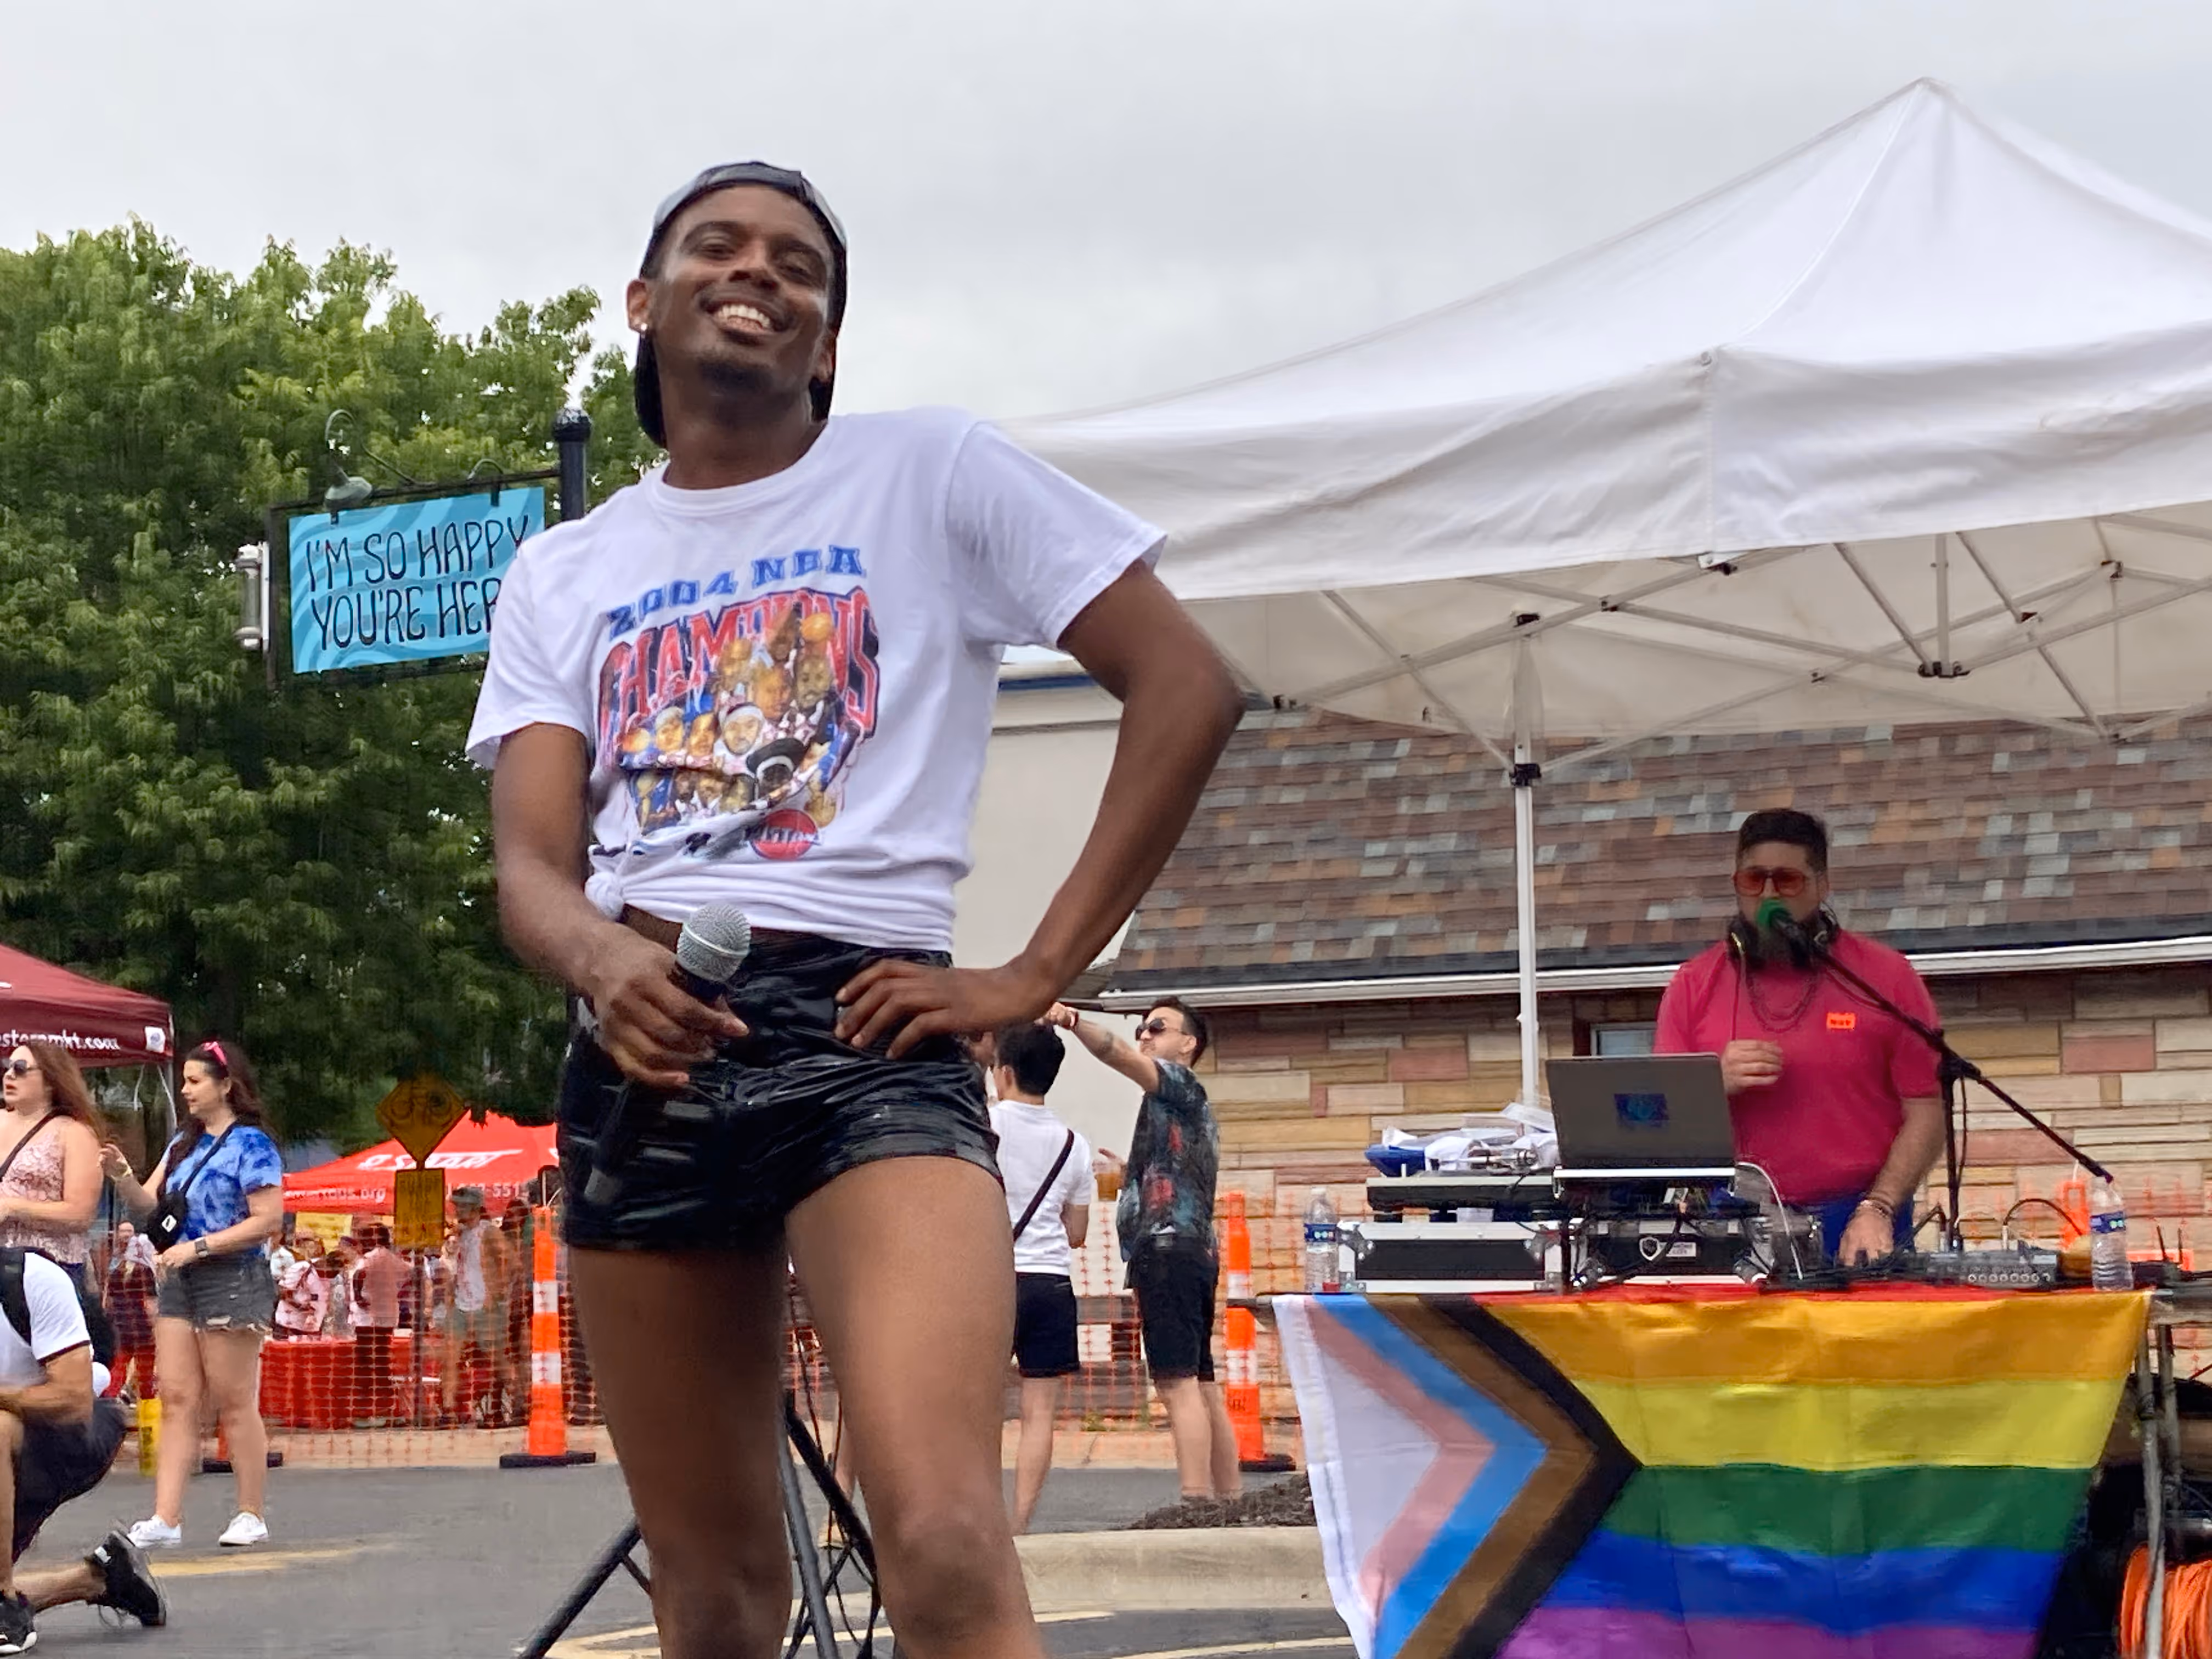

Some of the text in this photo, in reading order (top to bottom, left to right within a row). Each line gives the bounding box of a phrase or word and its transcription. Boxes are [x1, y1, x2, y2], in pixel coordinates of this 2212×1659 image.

[306, 514, 529, 592] I'M SO HAPPY
[311, 577, 503, 651] YOU'RE HER
[605, 544, 866, 643] 2004 NBA
